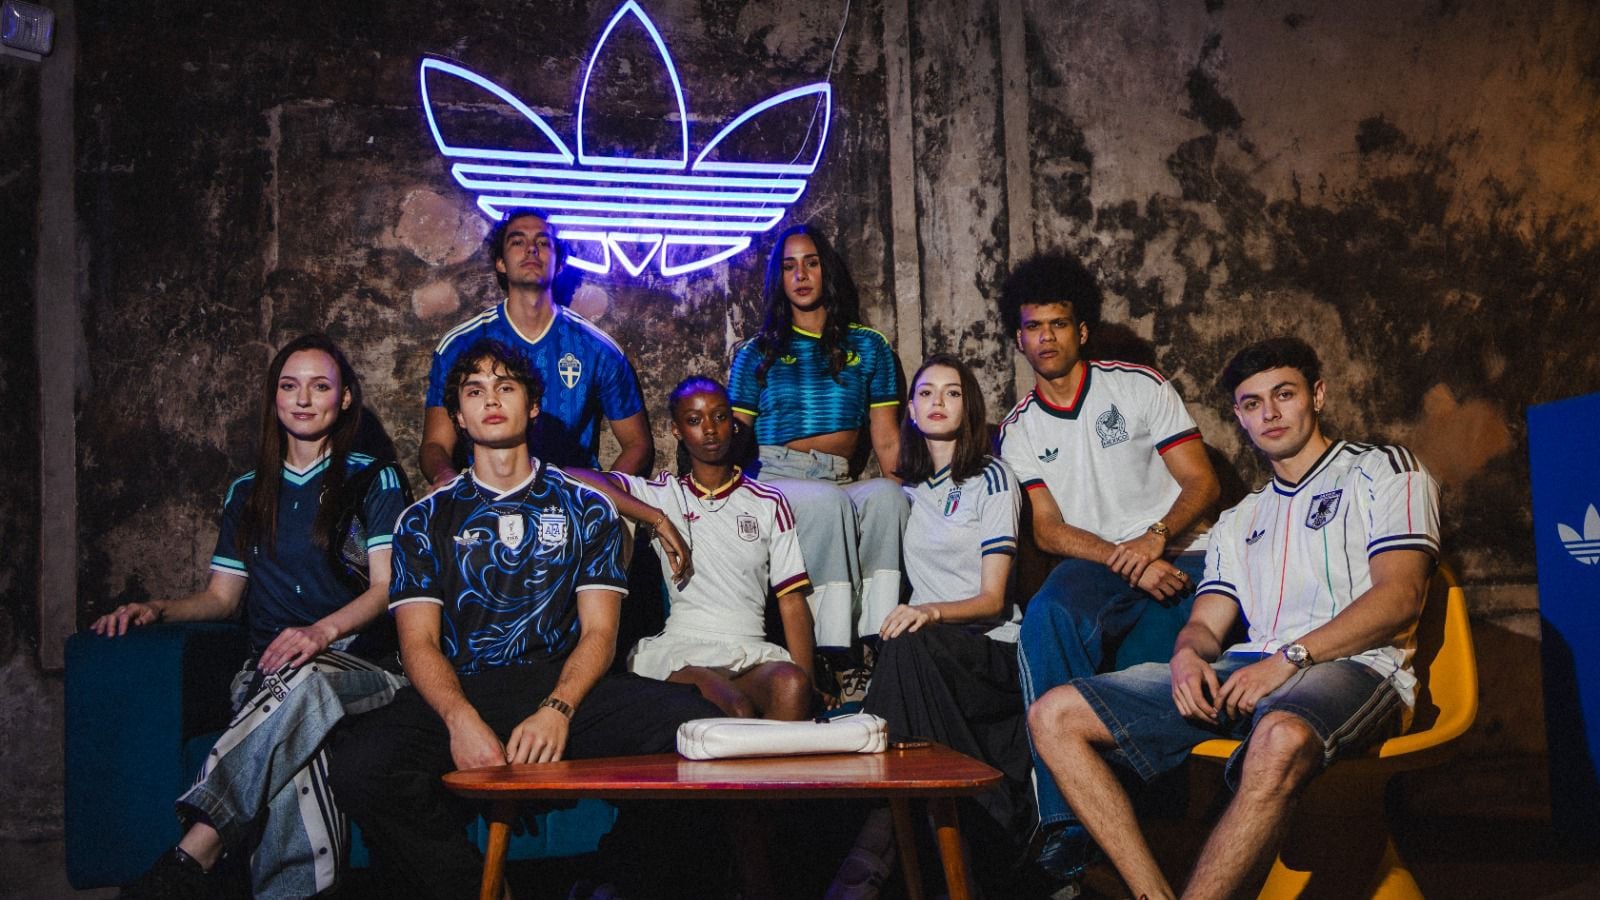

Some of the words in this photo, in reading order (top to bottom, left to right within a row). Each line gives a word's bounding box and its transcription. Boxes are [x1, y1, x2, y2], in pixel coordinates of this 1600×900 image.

[1102, 434, 1128, 447] MEXICO
[545, 523, 561, 537] AFA
[268, 677, 287, 699] das
